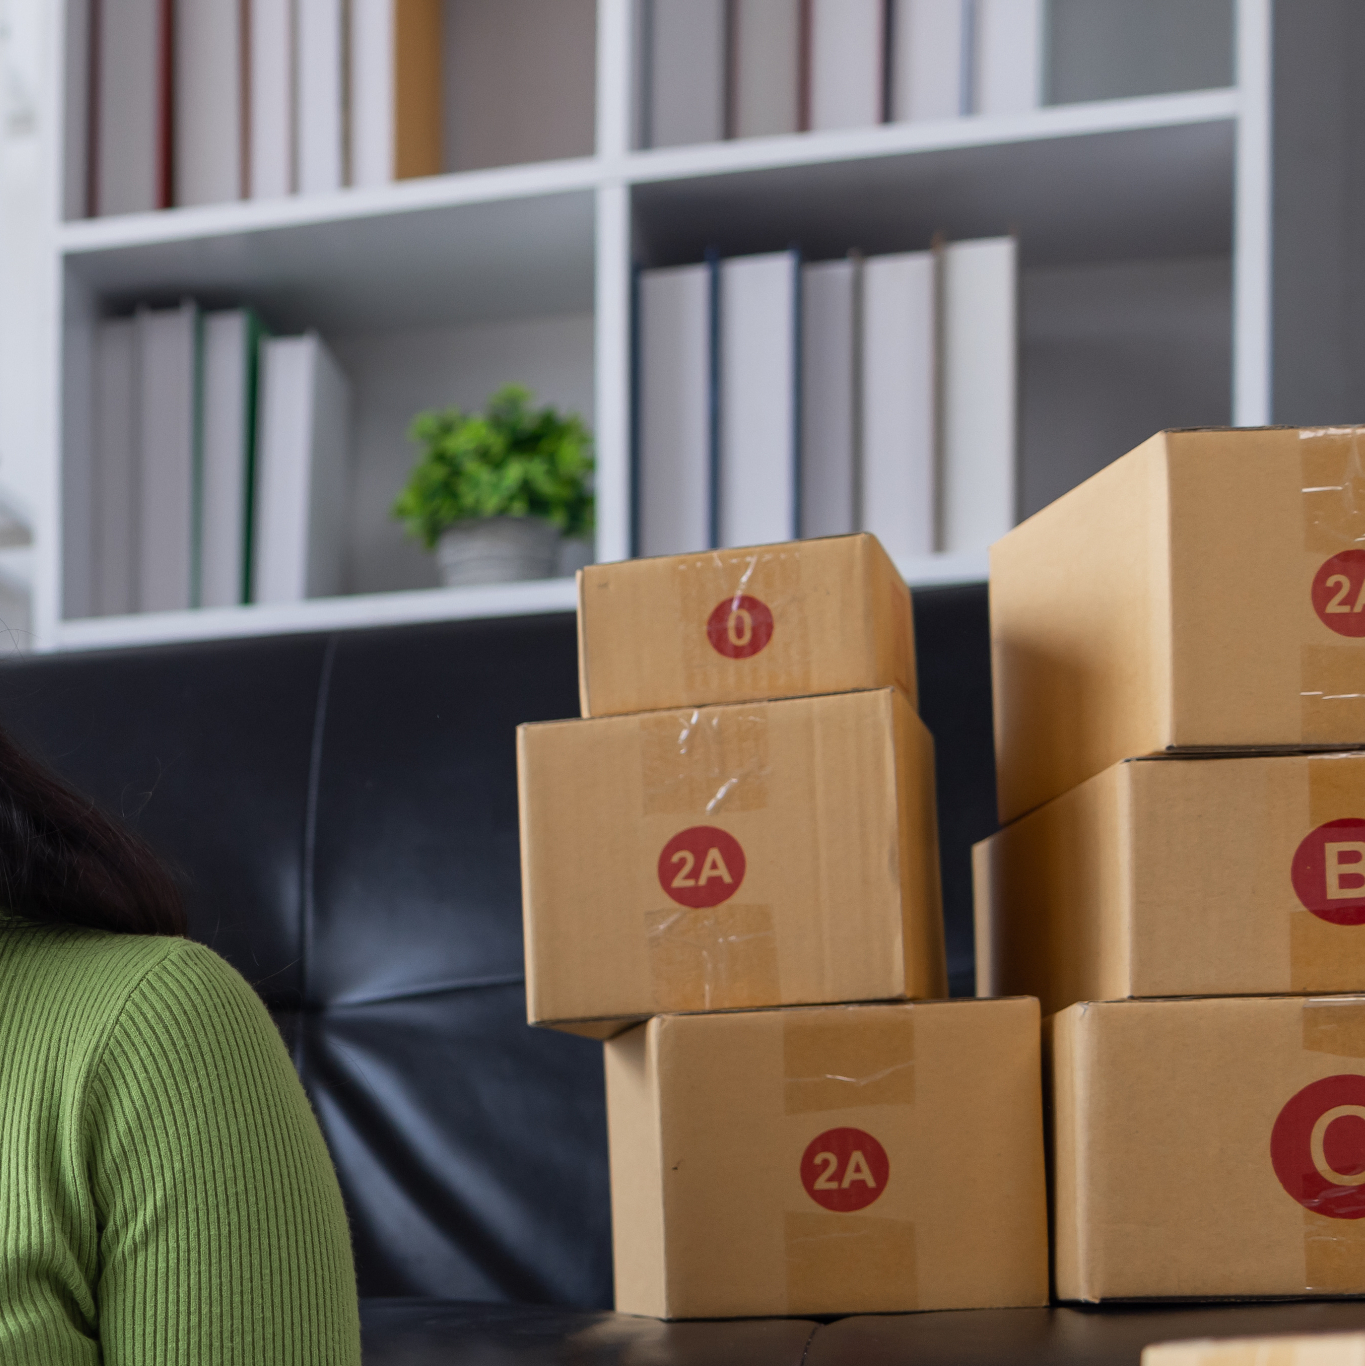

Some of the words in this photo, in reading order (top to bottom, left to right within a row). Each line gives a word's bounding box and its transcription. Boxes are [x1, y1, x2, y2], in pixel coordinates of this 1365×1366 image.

[670, 848, 732, 889] 2A
[1324, 841, 1365, 900] B
[812, 1151, 876, 1190] 2A
